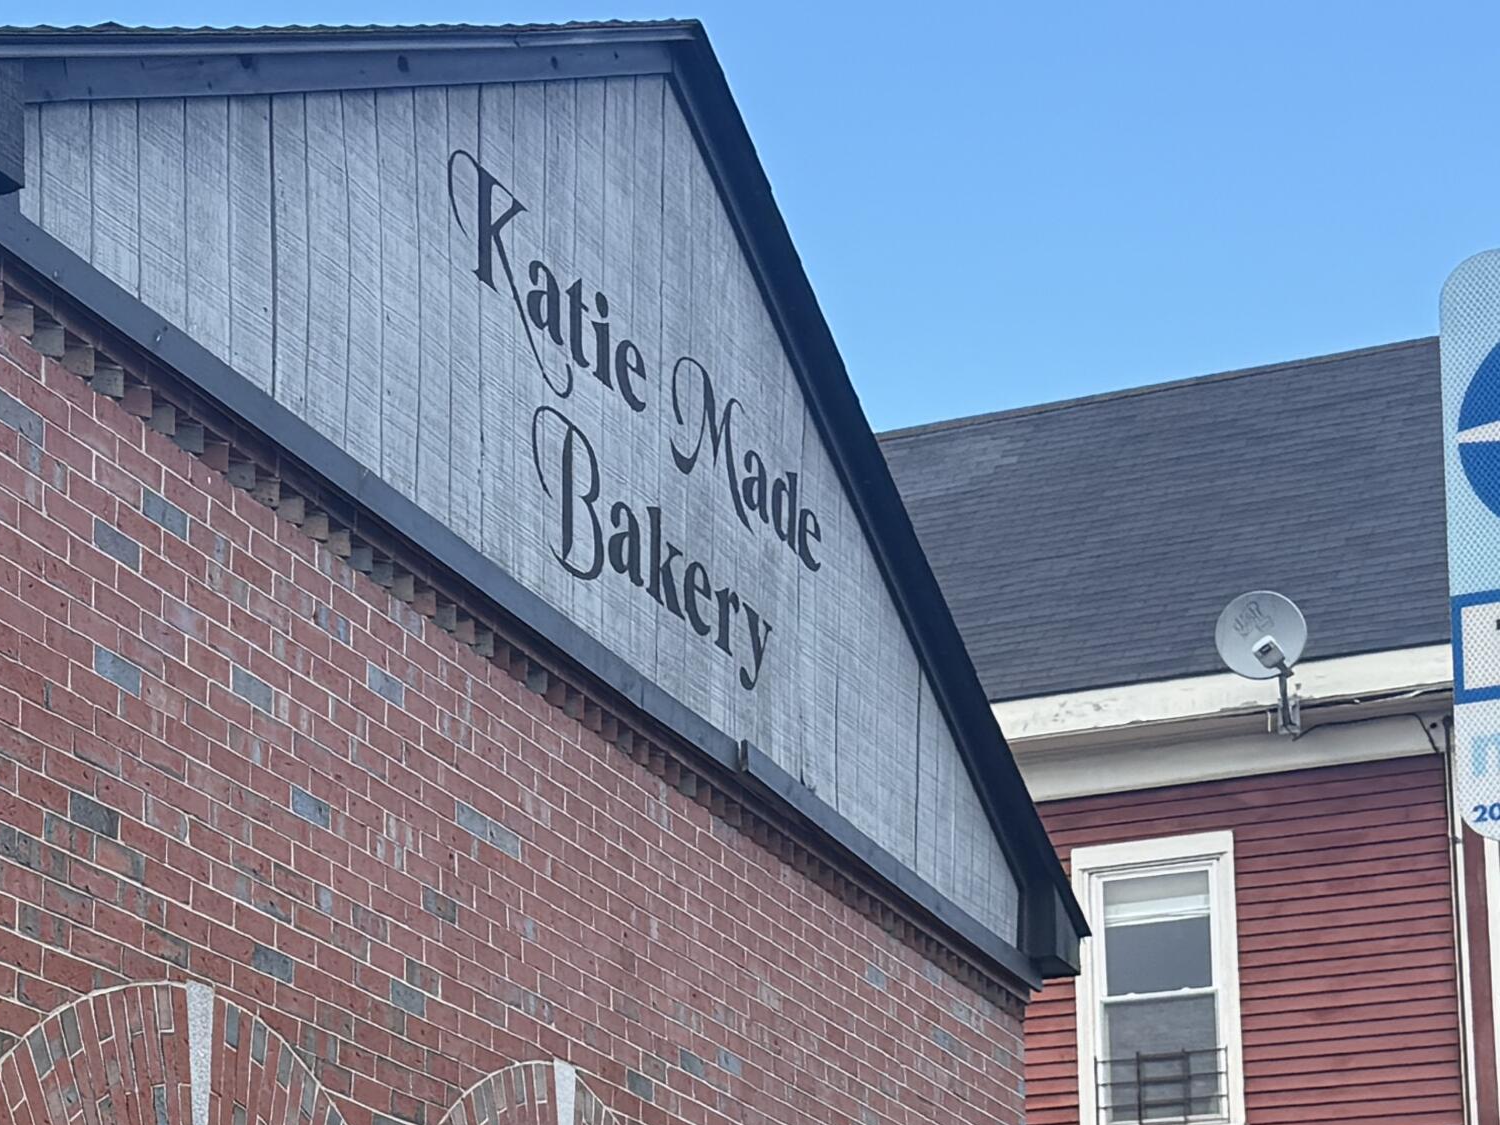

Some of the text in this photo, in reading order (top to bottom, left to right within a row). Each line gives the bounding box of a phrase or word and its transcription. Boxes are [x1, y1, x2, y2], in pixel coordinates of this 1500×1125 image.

[448, 149, 822, 572] Katie Made
[532, 405, 773, 691] Bakery
